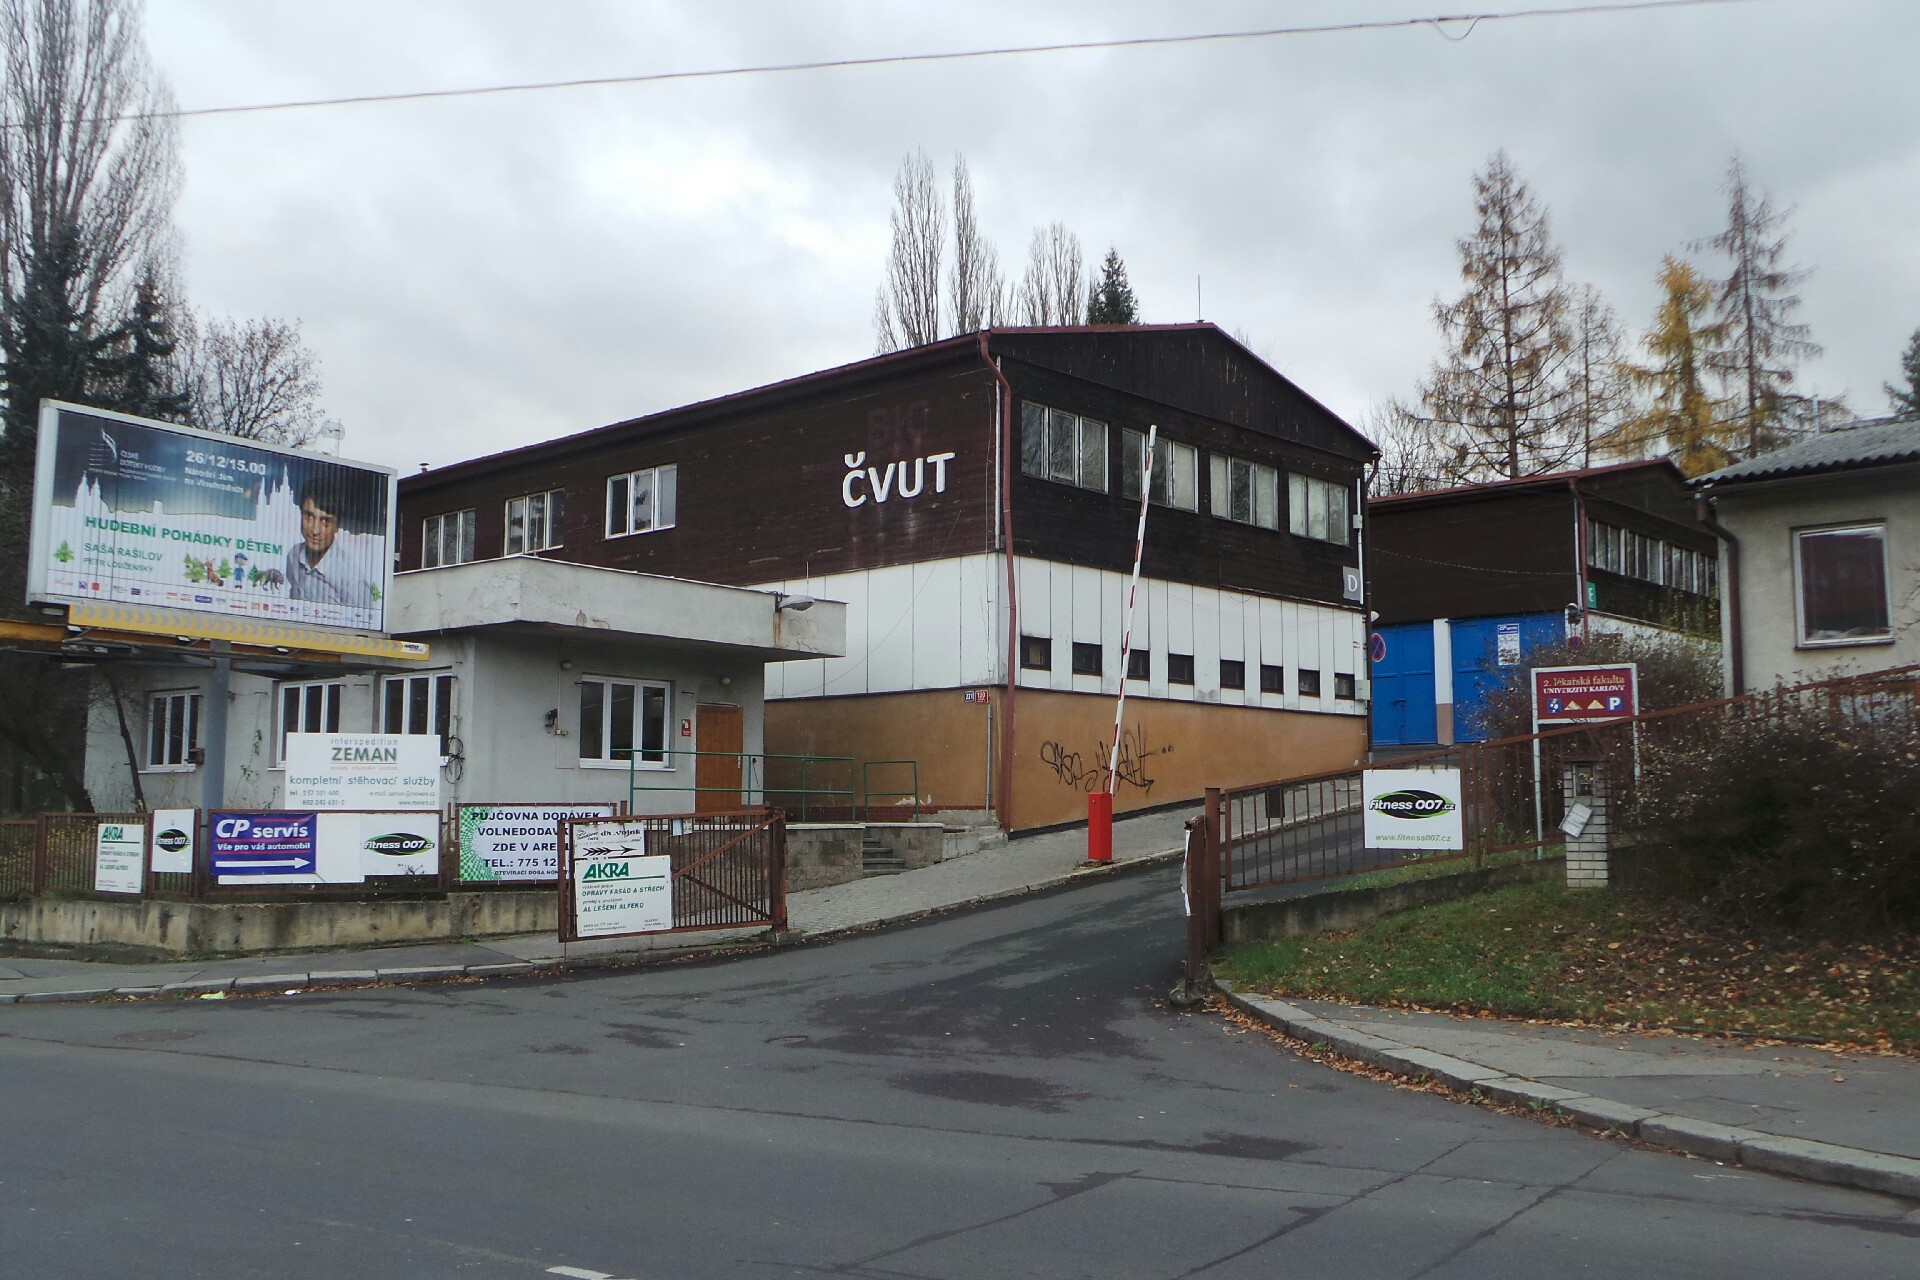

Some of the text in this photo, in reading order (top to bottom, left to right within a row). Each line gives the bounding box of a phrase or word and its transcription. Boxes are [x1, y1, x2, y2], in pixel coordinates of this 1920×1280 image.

[185, 450, 266, 476] 26/12/15.00
[843, 451, 956, 508] ČVUT
[85, 516, 283, 556] HUDEBNÍ POHÁDKY DĚTEM
[84, 542, 164, 562] SAŠA RAŠILOV
[1347, 574, 1358, 592] D
[1543, 679, 1552, 687] 2.
[1592, 674, 1626, 686] fakulta
[1543, 684, 1626, 695] UNIVERZITY KARLOVY
[1609, 697, 1621, 710] P
[330, 737, 398, 747] interspedition
[331, 747, 398, 762] ZEMAN
[289, 776, 436, 788] kompletní stěhovací služby
[1415, 799, 1456, 811] 007.cz
[472, 810, 601, 821] PŮJČOVNA DODÁVEK
[101, 826, 124, 841] AKRA
[216, 819, 309, 839] CP servis
[1375, 833, 1452, 842] www.fitness007.cz
[217, 842, 311, 853] Vše pro váš automobil
[492, 843, 517, 852] ZDE
[520, 843, 530, 852] V
[483, 858, 557, 868] TEL.: 775 12
[582, 862, 630, 880] AKRA
[582, 889, 609, 897] OPRAVY
[609, 887, 632, 895] FASÁD
[639, 885, 665, 893] STŘECH
[594, 904, 617, 912] LEŠENÍ
